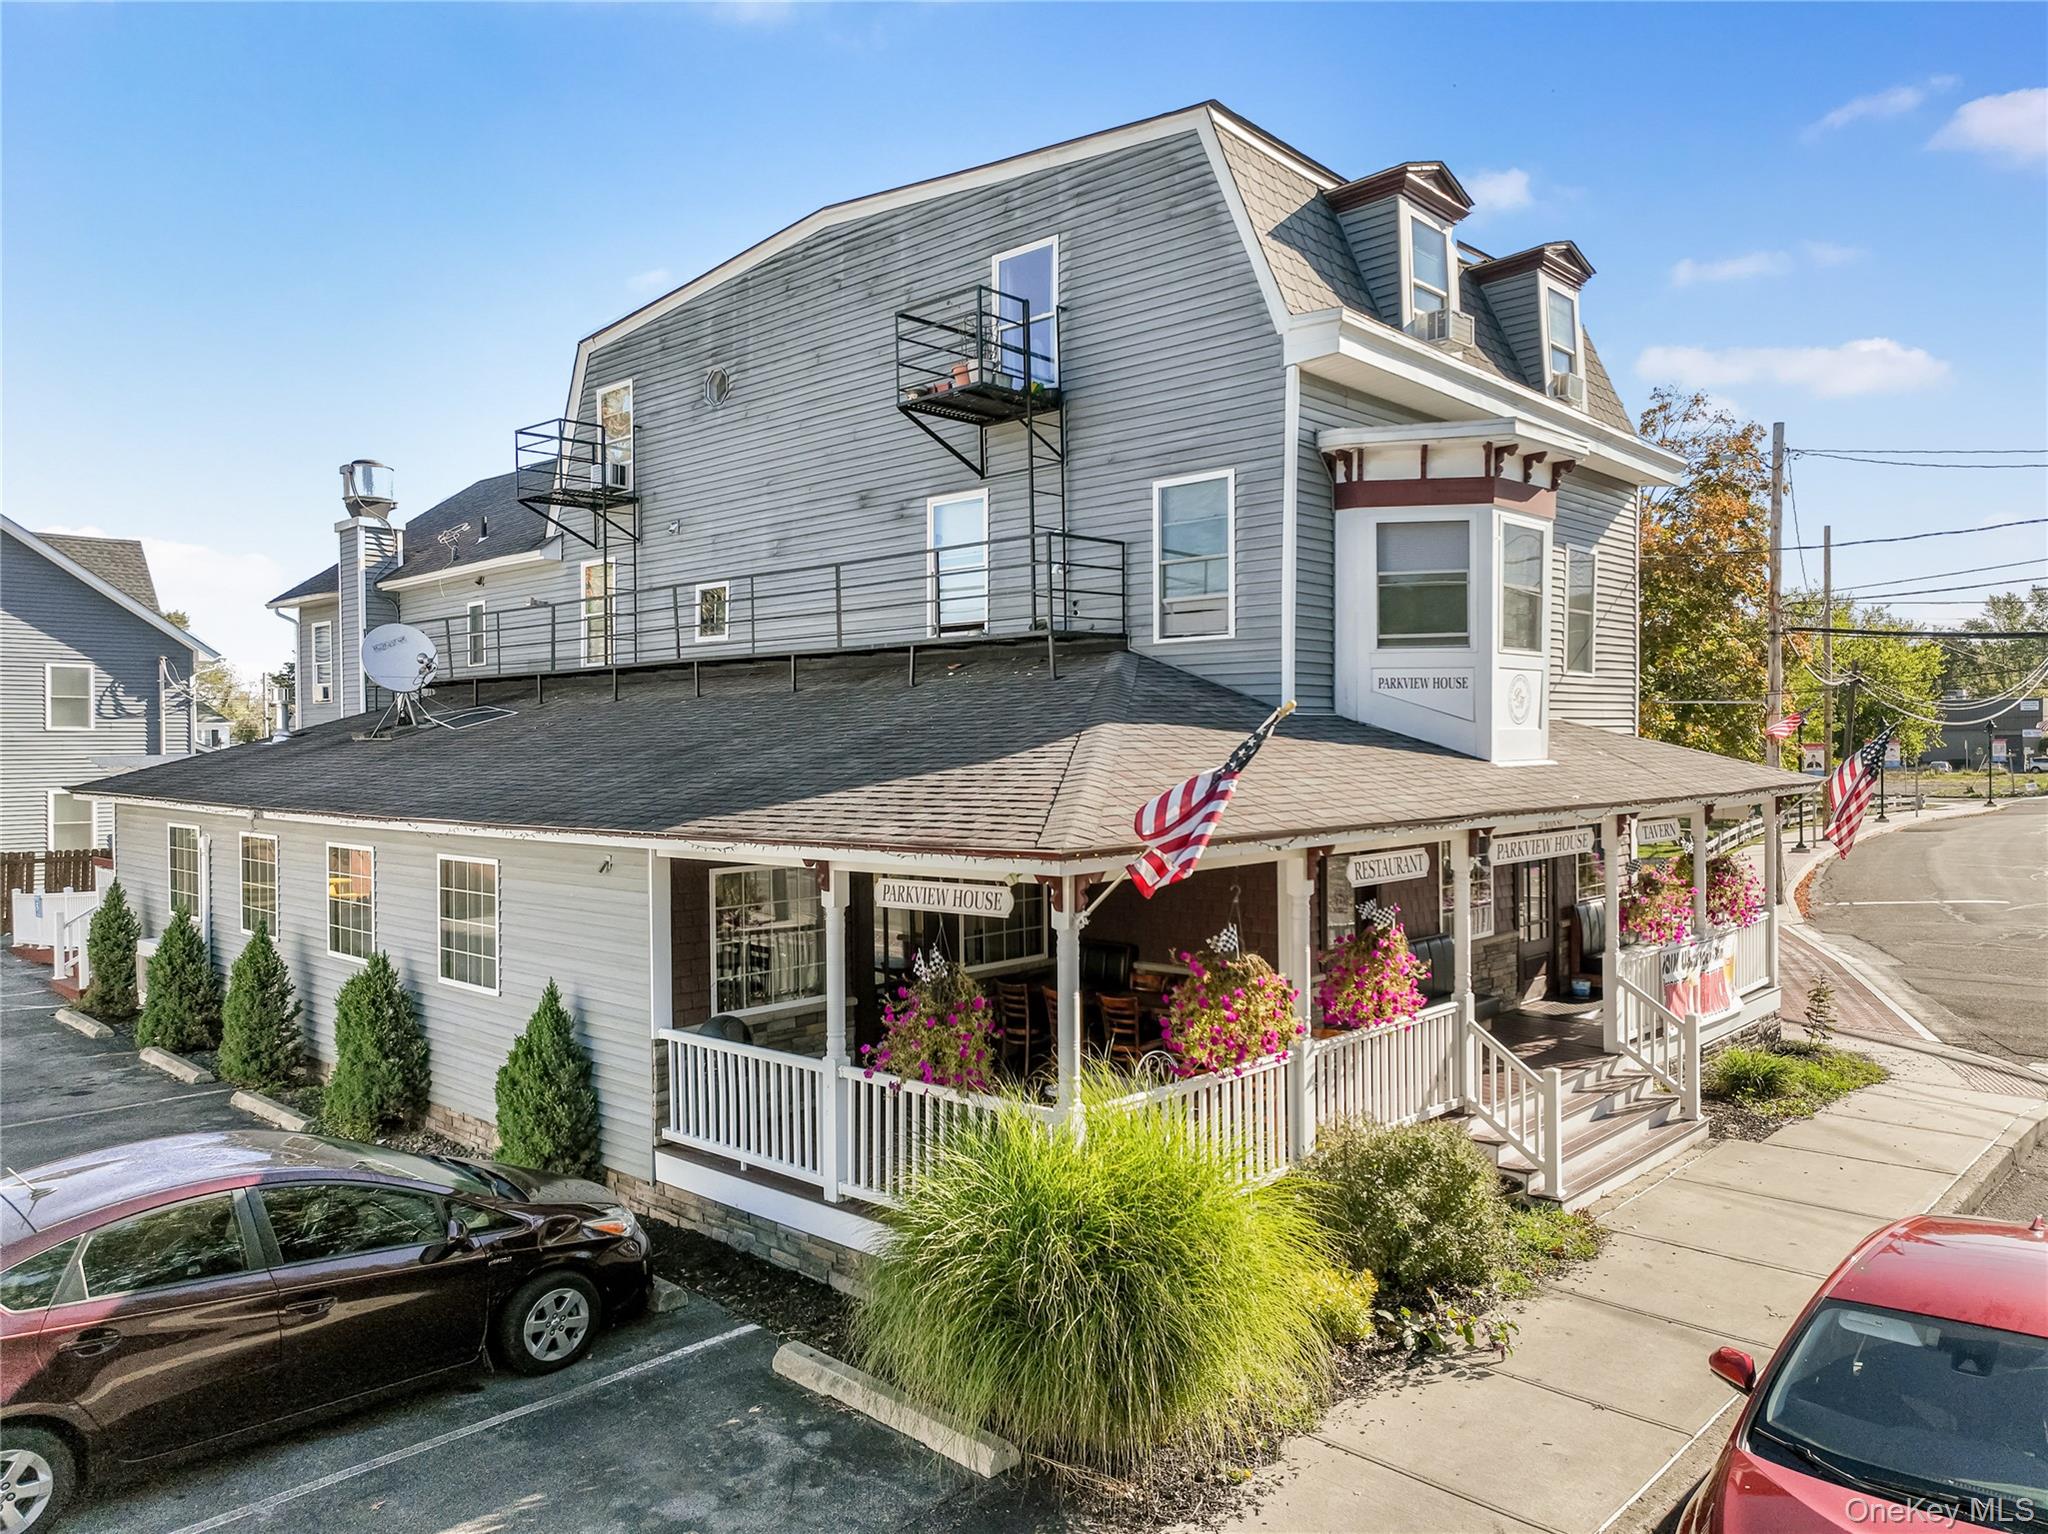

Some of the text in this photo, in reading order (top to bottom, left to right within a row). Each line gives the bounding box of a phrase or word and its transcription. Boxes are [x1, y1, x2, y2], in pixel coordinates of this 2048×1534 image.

[1378, 676, 1469, 690] PARKVIEW HOUSE
[1642, 822, 1677, 840] TAVERN
[1496, 832, 1589, 861] PARKVIEW HOUSE
[1353, 853, 1424, 881] RESTAURANT
[882, 883, 1003, 911] PARKVIEW HOUSE
